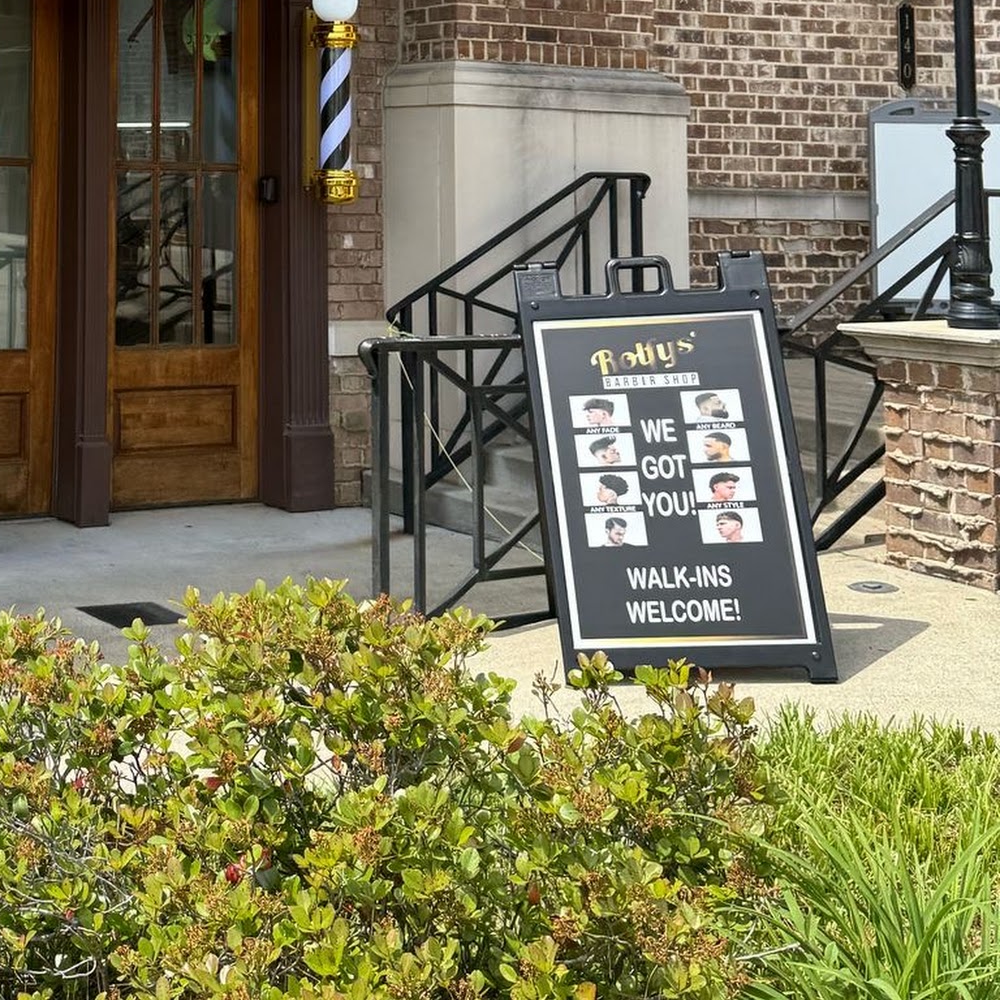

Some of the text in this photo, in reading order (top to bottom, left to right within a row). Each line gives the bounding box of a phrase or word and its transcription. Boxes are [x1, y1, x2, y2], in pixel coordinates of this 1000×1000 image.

[664, 373, 697, 385] SHOP
[602, 426, 620, 434] FADE
[640, 418, 677, 443] WE
[641, 454, 686, 480] GOT
[641, 491, 697, 517] YOU!
[723, 501, 744, 509] STYLE
[626, 564, 732, 590] WALK-INS
[626, 598, 741, 624] WELCOME!
